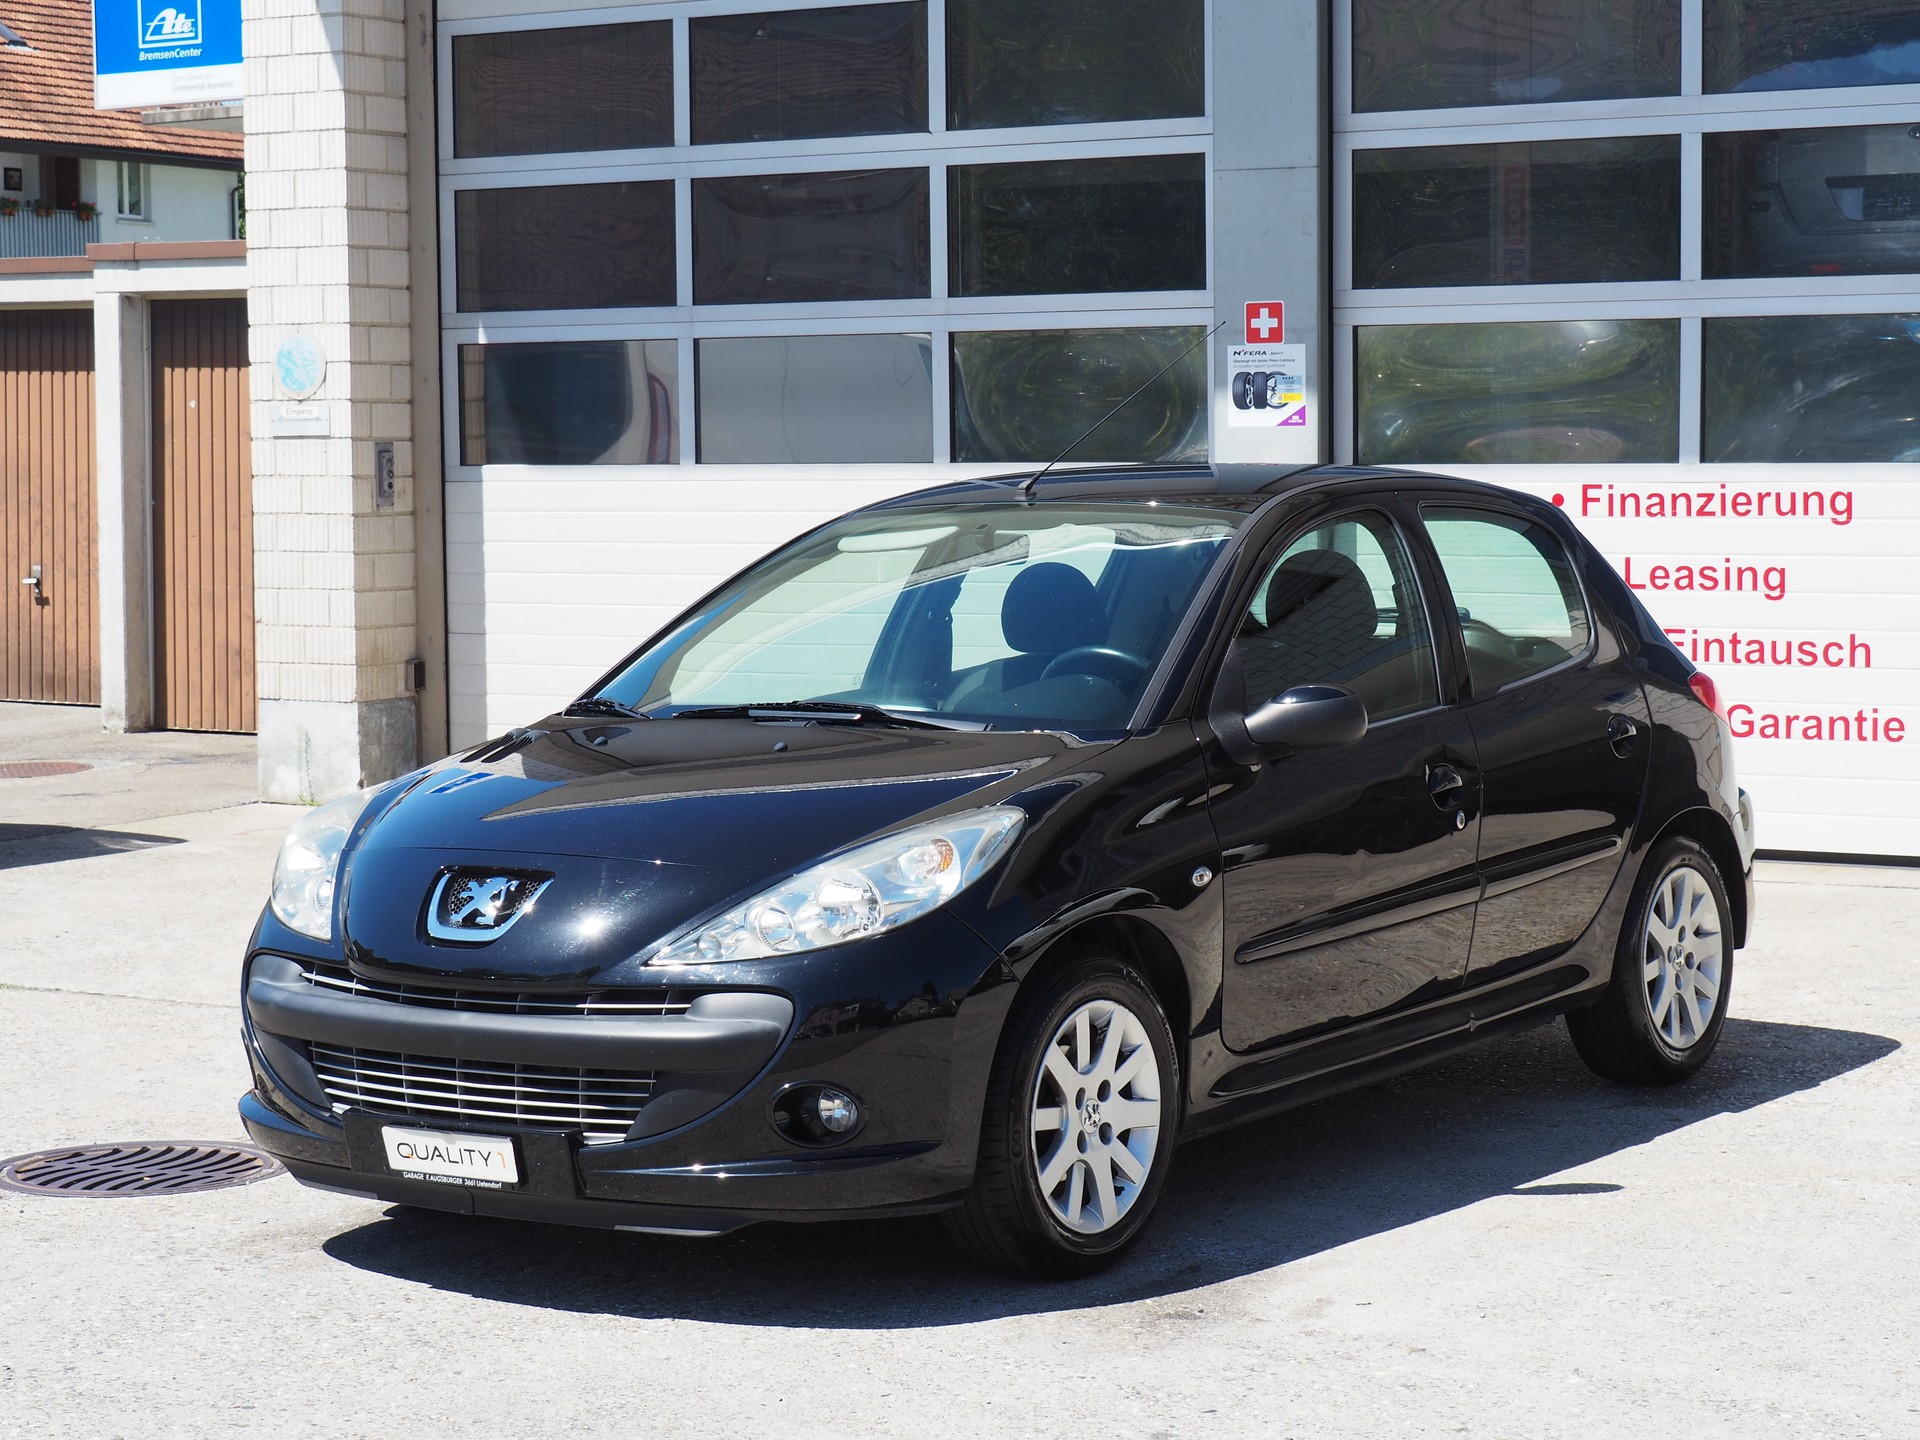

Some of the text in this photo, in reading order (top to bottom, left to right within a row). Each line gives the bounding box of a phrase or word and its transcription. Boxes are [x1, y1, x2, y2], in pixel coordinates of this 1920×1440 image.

[139, 48, 203, 61] BremsenCenter
[286, 407, 313, 417] Eingang
[1581, 483, 1853, 526] Finanzierung
[1624, 556, 1786, 601] Leasing
[1727, 703, 1905, 743] Garantie
[396, 1142, 507, 1169] QUALITY 1
[402, 1171, 424, 1181] GARAGE
[464, 1178, 476, 1187] 3661
[476, 1179, 502, 1189] Uetendorf
